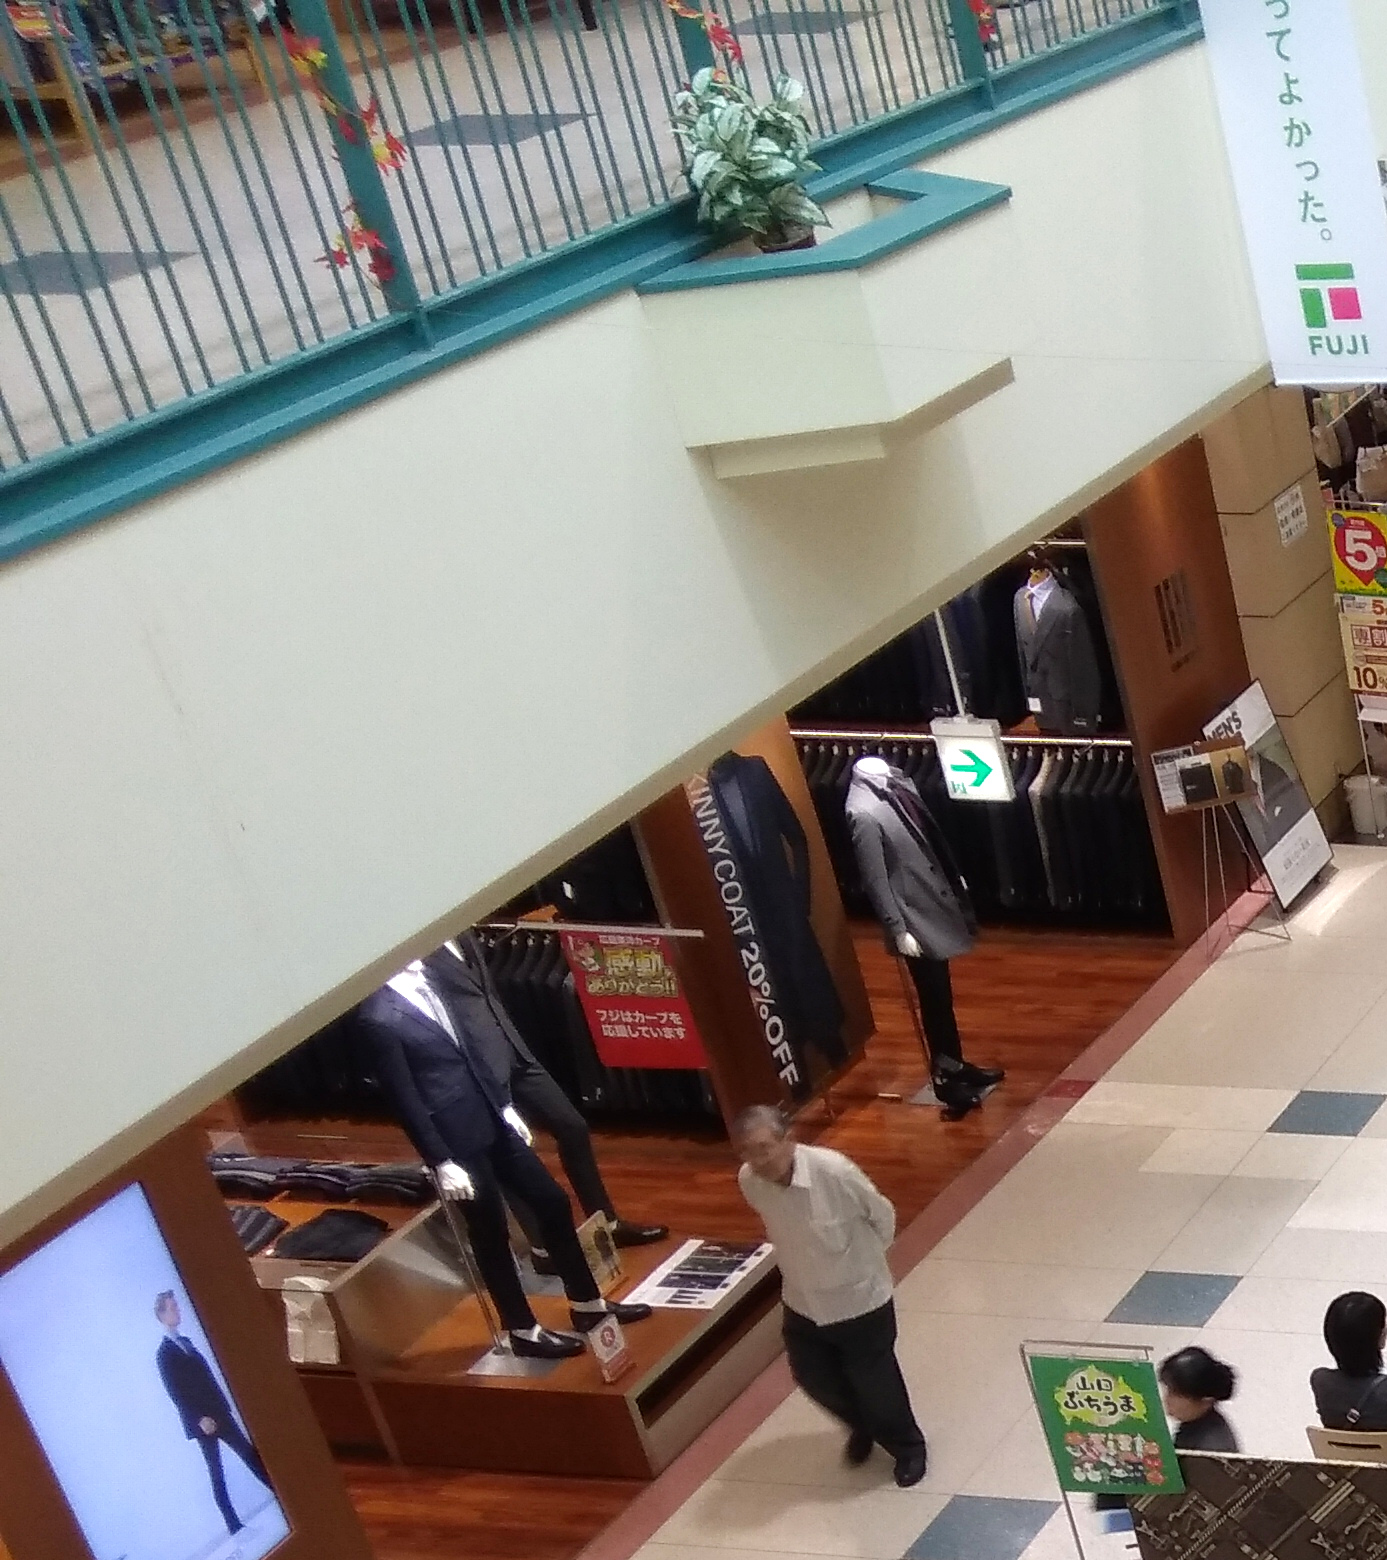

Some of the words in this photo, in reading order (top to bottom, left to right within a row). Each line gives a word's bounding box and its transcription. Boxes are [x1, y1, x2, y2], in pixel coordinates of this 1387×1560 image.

[1308, 334, 1370, 356] FUJI
[596, 1009, 683, 1026] フジはカープを
[602, 1024, 686, 1039] 応援しています
[1076, 1376, 1114, 1392] 山口
[1063, 1391, 1137, 1416] ぶちうま
